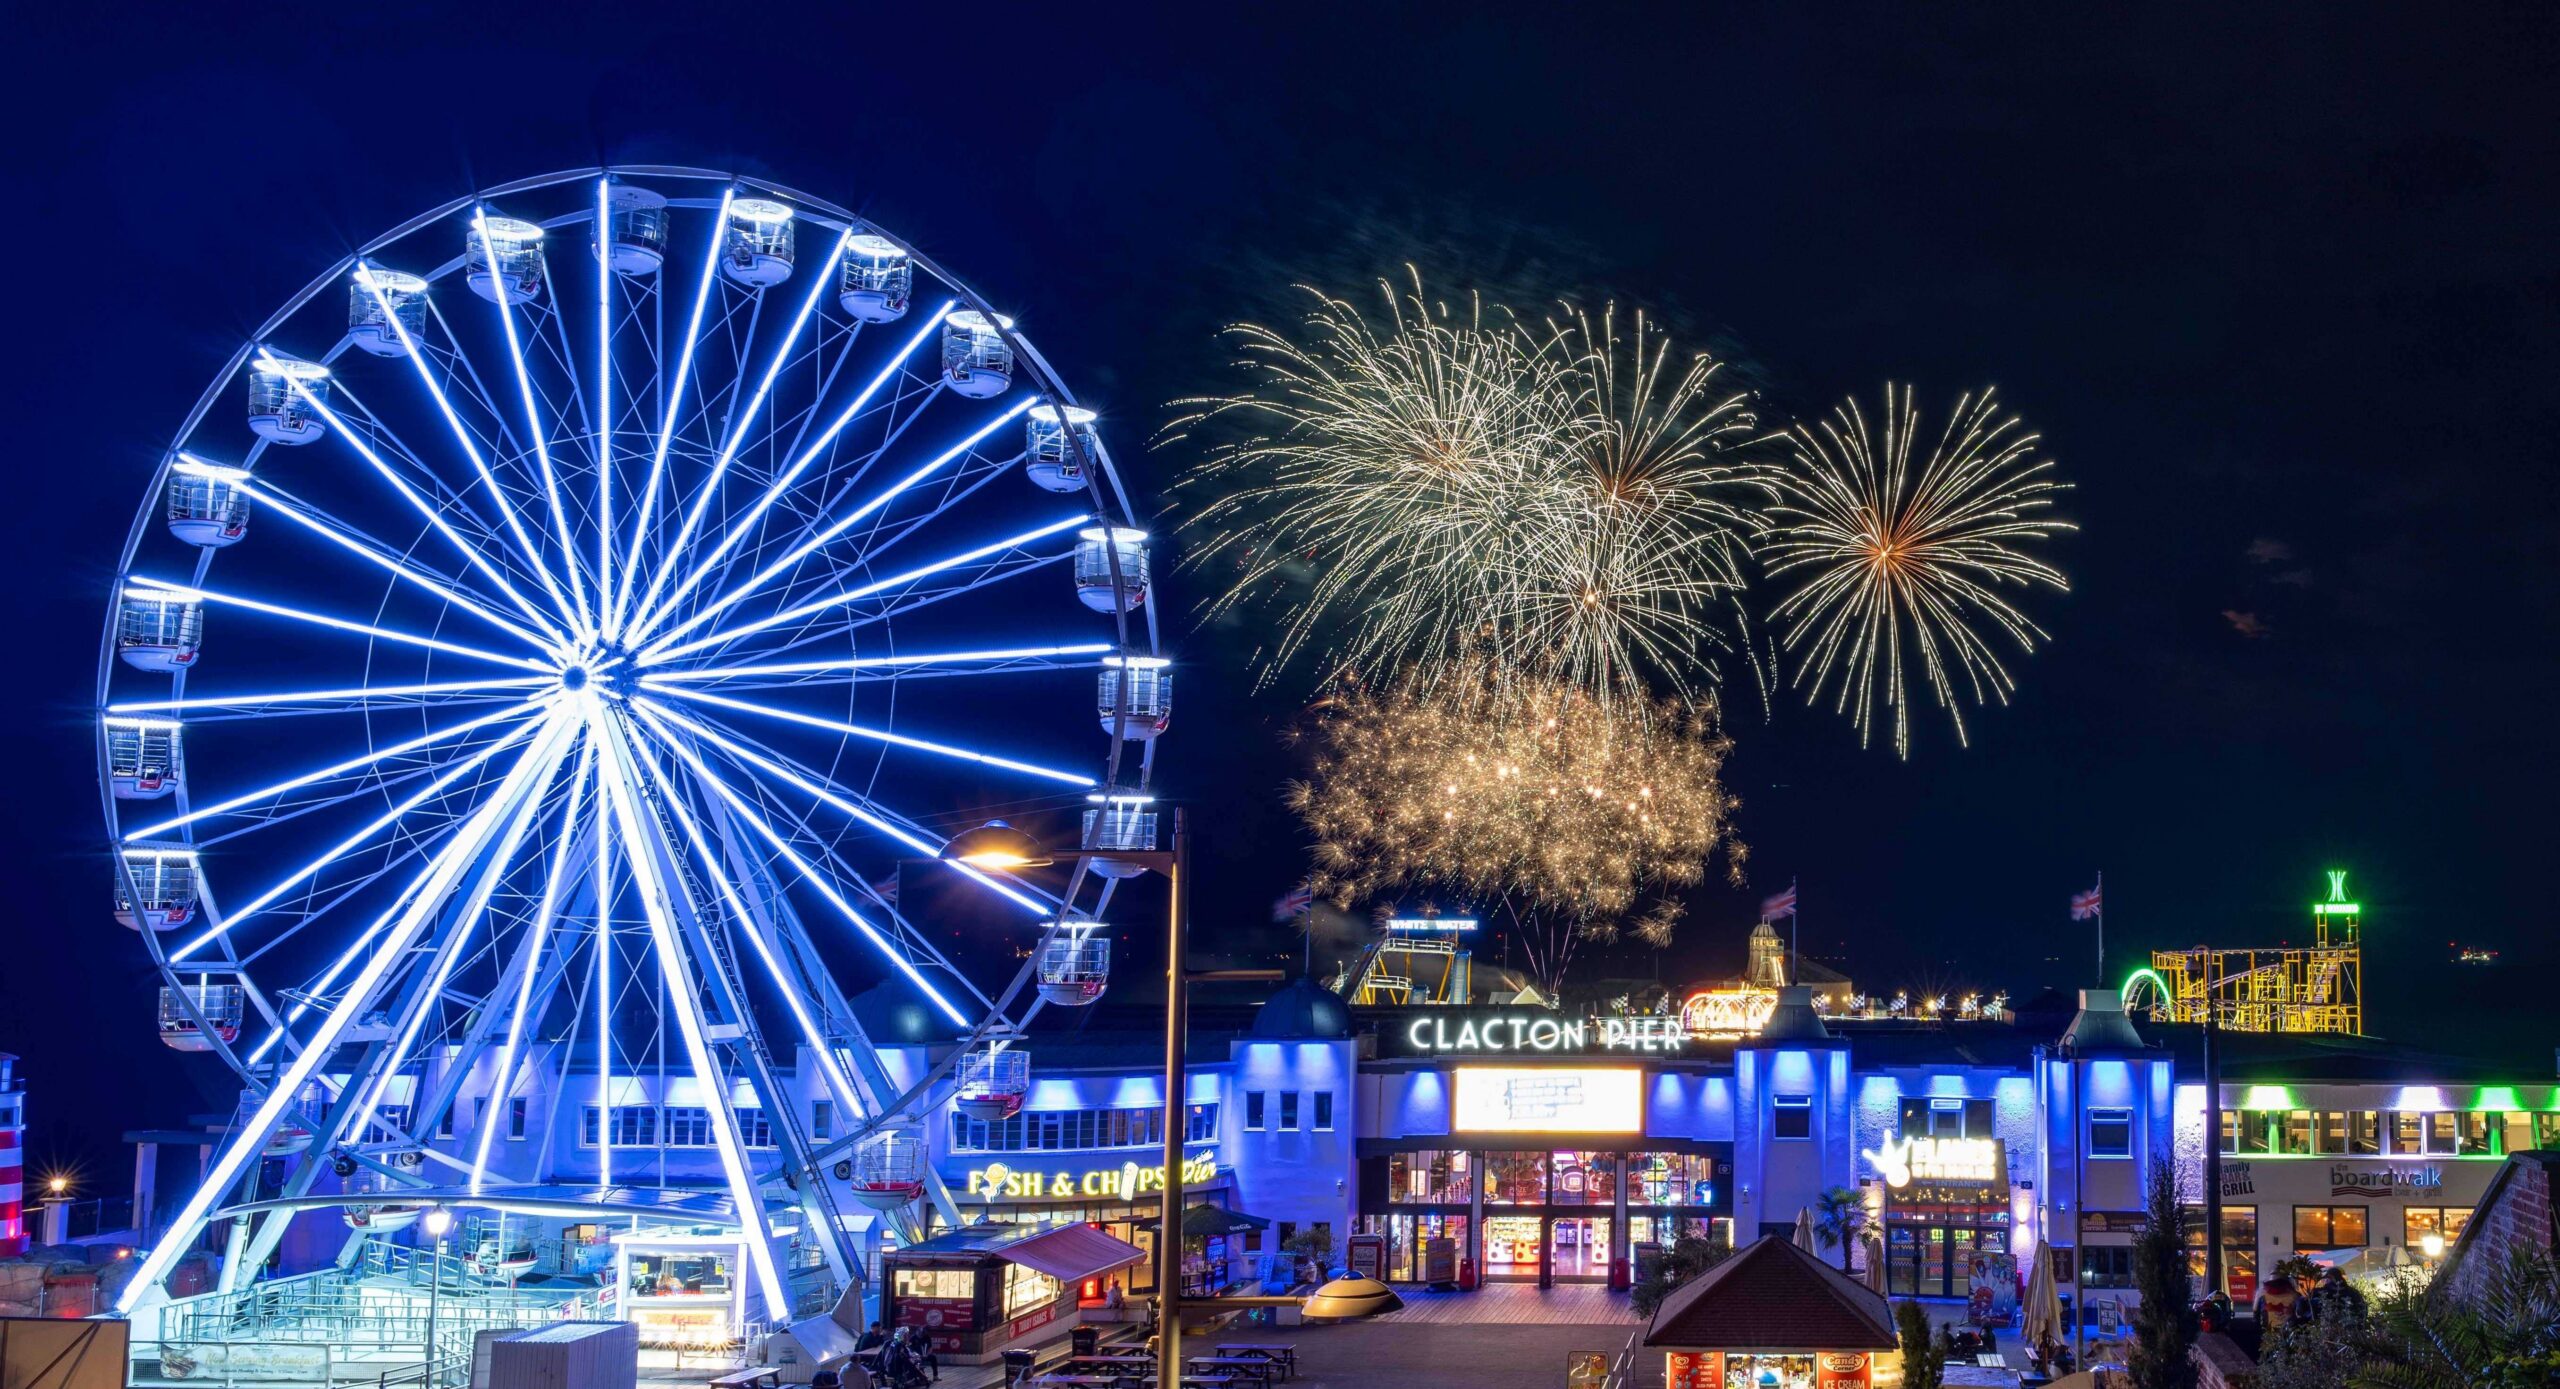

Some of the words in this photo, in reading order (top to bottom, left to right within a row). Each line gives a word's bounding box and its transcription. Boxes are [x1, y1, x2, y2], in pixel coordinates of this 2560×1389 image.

[1390, 920, 1428, 930] WHITE
[1435, 920, 1476, 930] WATER
[1408, 1017, 1585, 1050] CLACTON
[1606, 1018, 1682, 1050] PIER
[2330, 1166, 2442, 1186] boardwalk
[1051, 1171, 1074, 1196] &
[1935, 1180, 1983, 1188] ENTRANCE
[2222, 1180, 2255, 1197] GRILL
[2395, 1186, 2410, 1196] bar
[2423, 1186, 2442, 1198] grill
[1018, 1317, 1032, 1333] TUBBY
[1032, 1311, 1047, 1327] ISAACS
[2101, 1317, 2115, 1326] OPEN
[271, 1352, 321, 1368] Breakfast
[1826, 1355, 1862, 1367] Candy
[1823, 1379, 1835, 1389] ICE
[1837, 1379, 1865, 1389] CREAM
